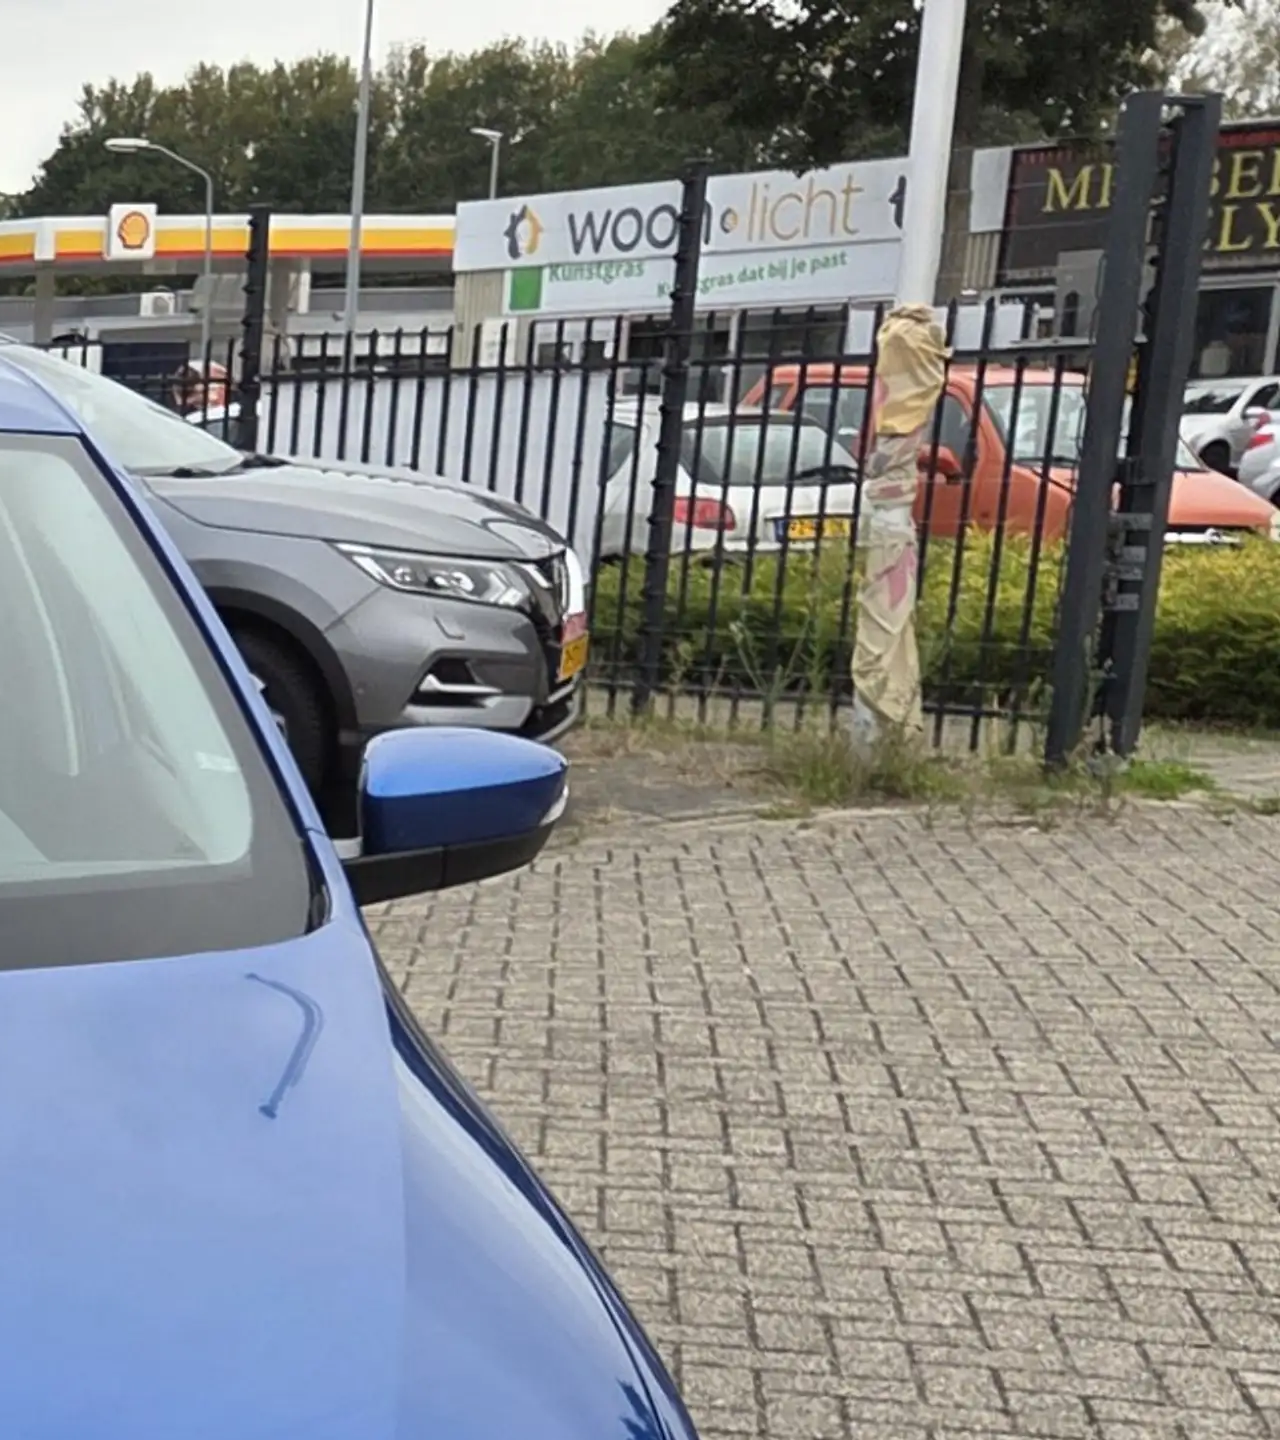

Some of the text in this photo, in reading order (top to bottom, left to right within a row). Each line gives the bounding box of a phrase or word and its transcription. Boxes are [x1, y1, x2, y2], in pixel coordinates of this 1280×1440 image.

[746, 173, 865, 243] licht
[737, 264, 765, 284] dat
[768, 256, 788, 281] bij
[789, 256, 807, 280] je
[810, 250, 848, 276] past
